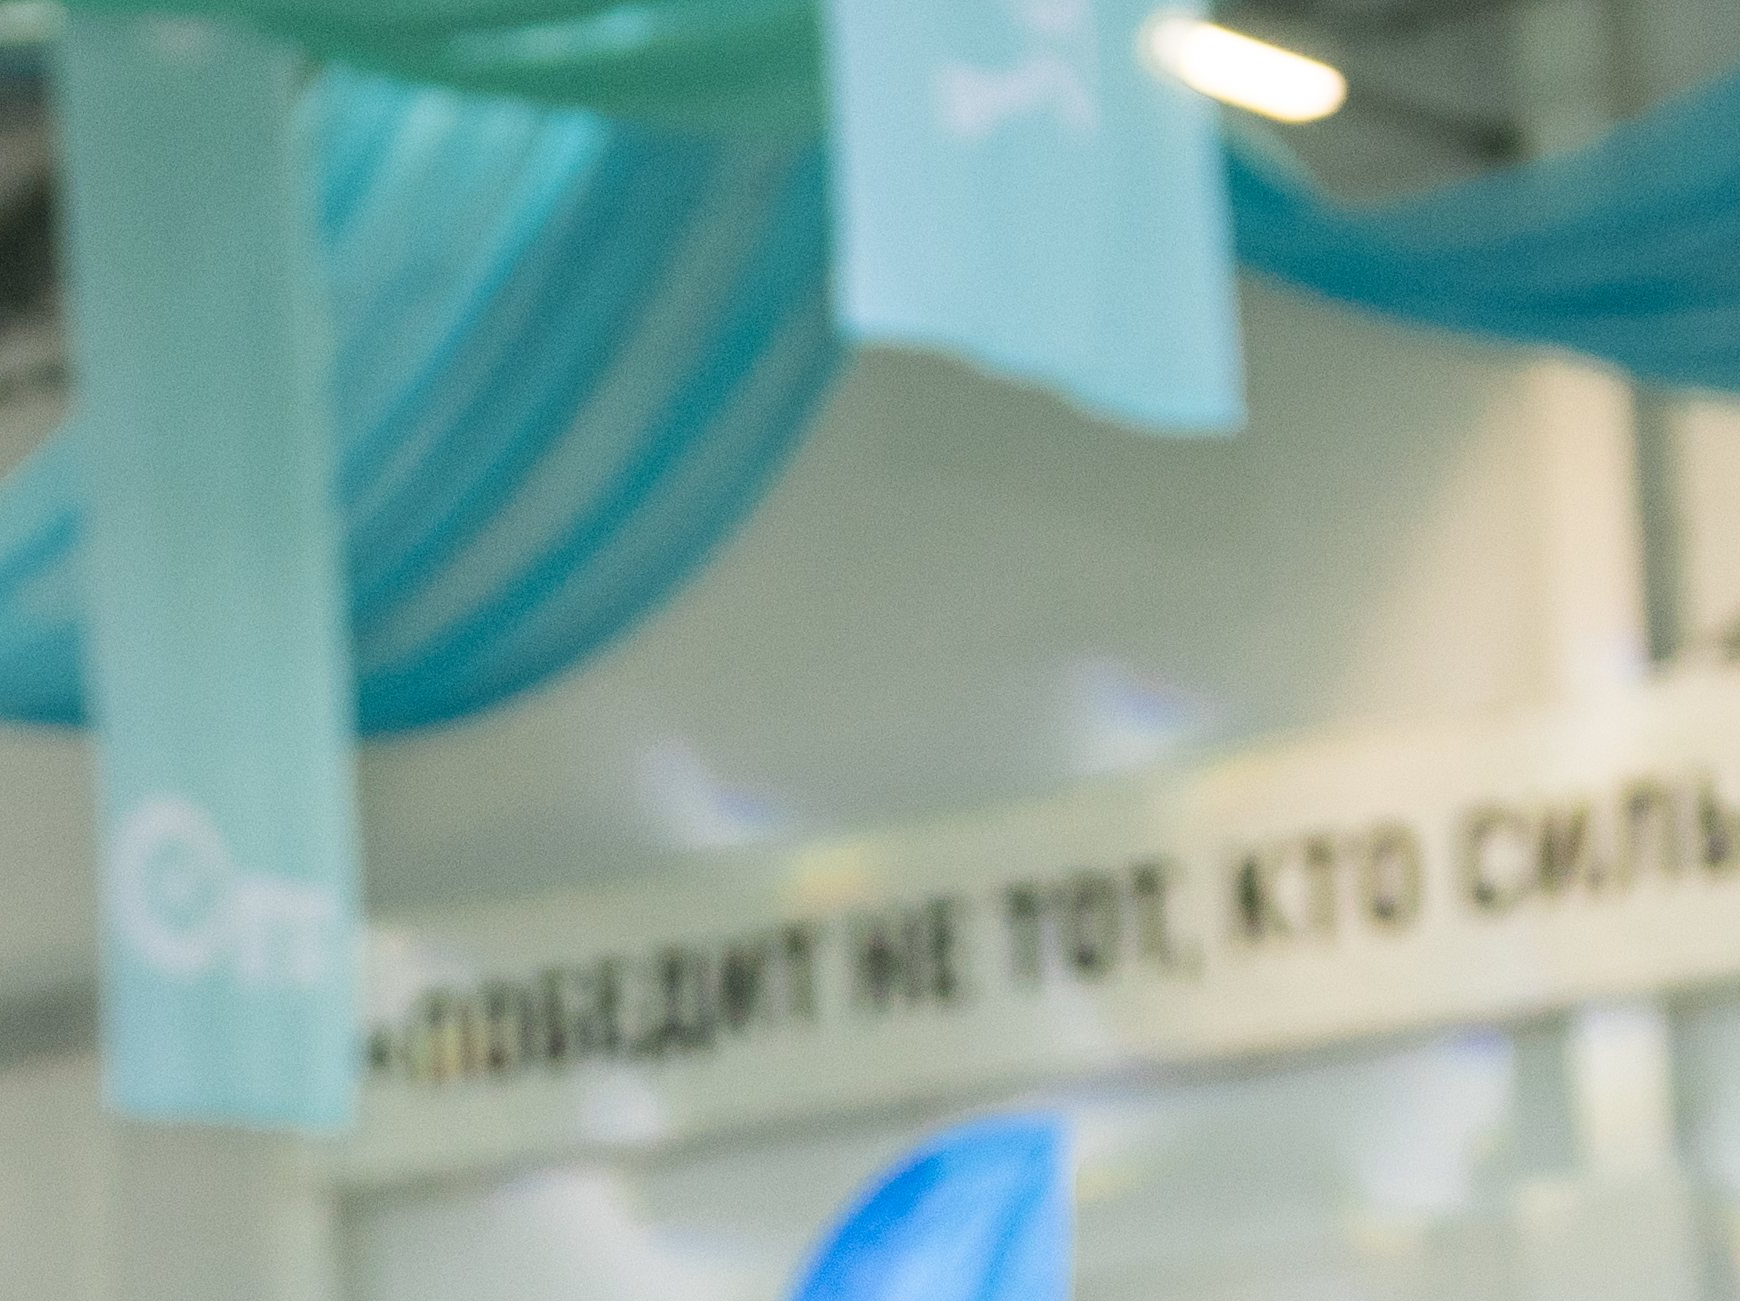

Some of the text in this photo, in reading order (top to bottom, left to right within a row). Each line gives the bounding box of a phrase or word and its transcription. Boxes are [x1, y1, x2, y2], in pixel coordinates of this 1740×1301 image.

[846, 893, 965, 1013] НЕ
[1004, 862, 1205, 990] ТОТ,
[1230, 824, 1420, 955] КТО
